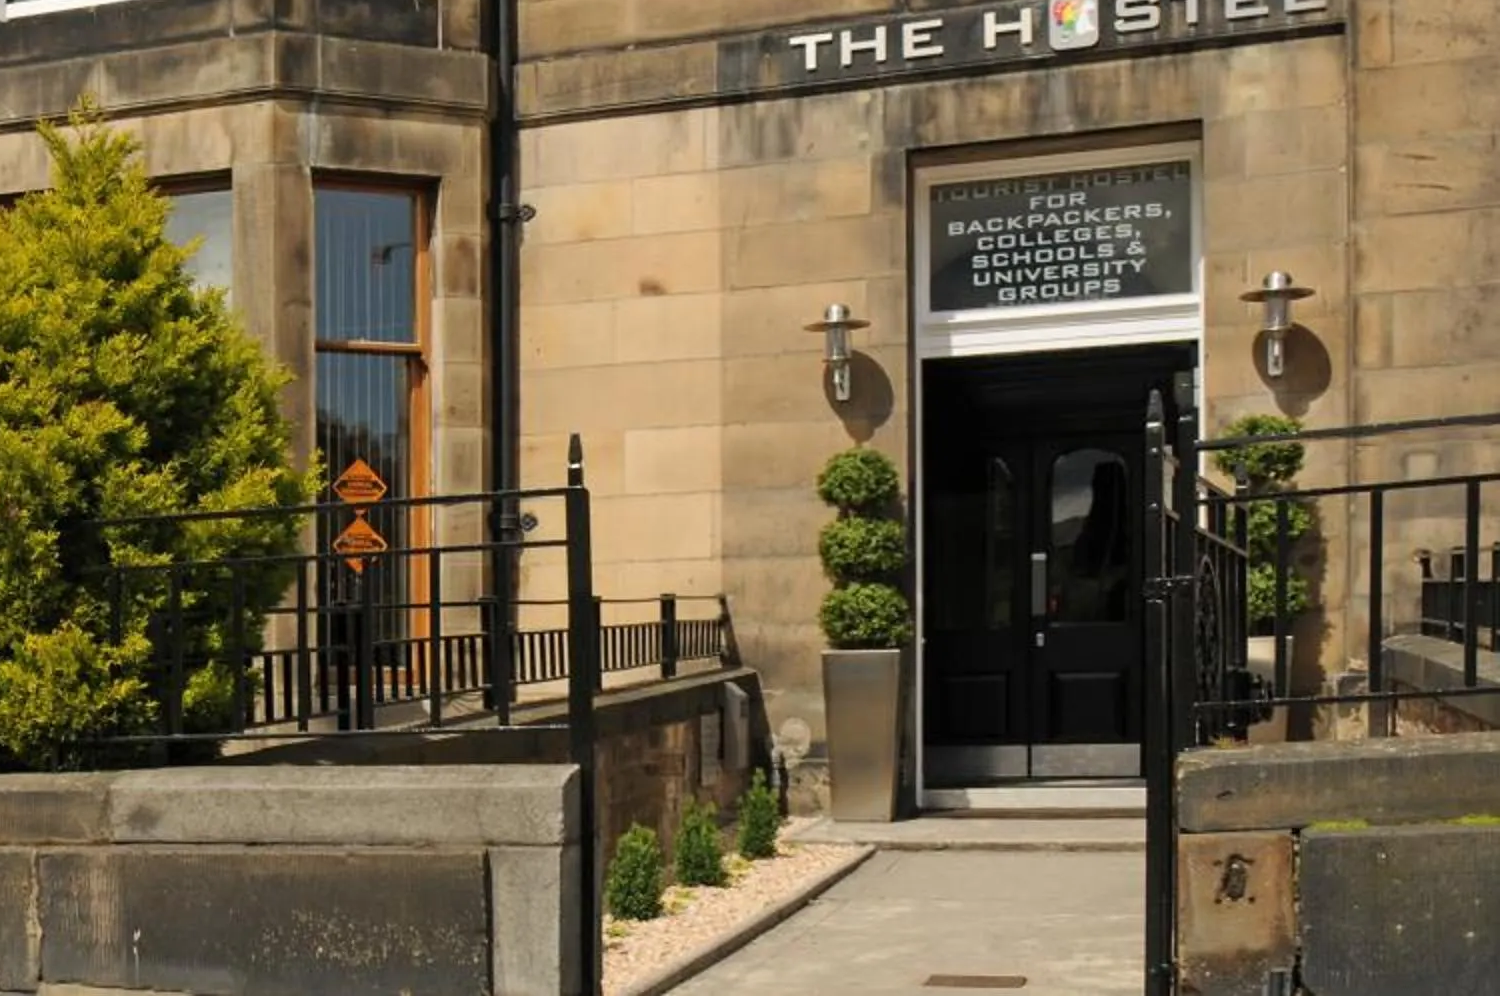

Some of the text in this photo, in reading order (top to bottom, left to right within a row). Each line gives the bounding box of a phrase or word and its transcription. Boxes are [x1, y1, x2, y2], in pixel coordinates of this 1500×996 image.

[788, 17, 945, 73] THE
[935, 164, 1189, 203] TOURIST HOSTEL
[1029, 191, 1088, 211] FOR
[948, 203, 1173, 237] BACKPACKERS,
[977, 223, 1143, 251] COLLEGES,
[972, 240, 1147, 270] SCHOOLS &
[973, 258, 1148, 287] UNIVERSITY
[998, 278, 1122, 302] GROUPS
